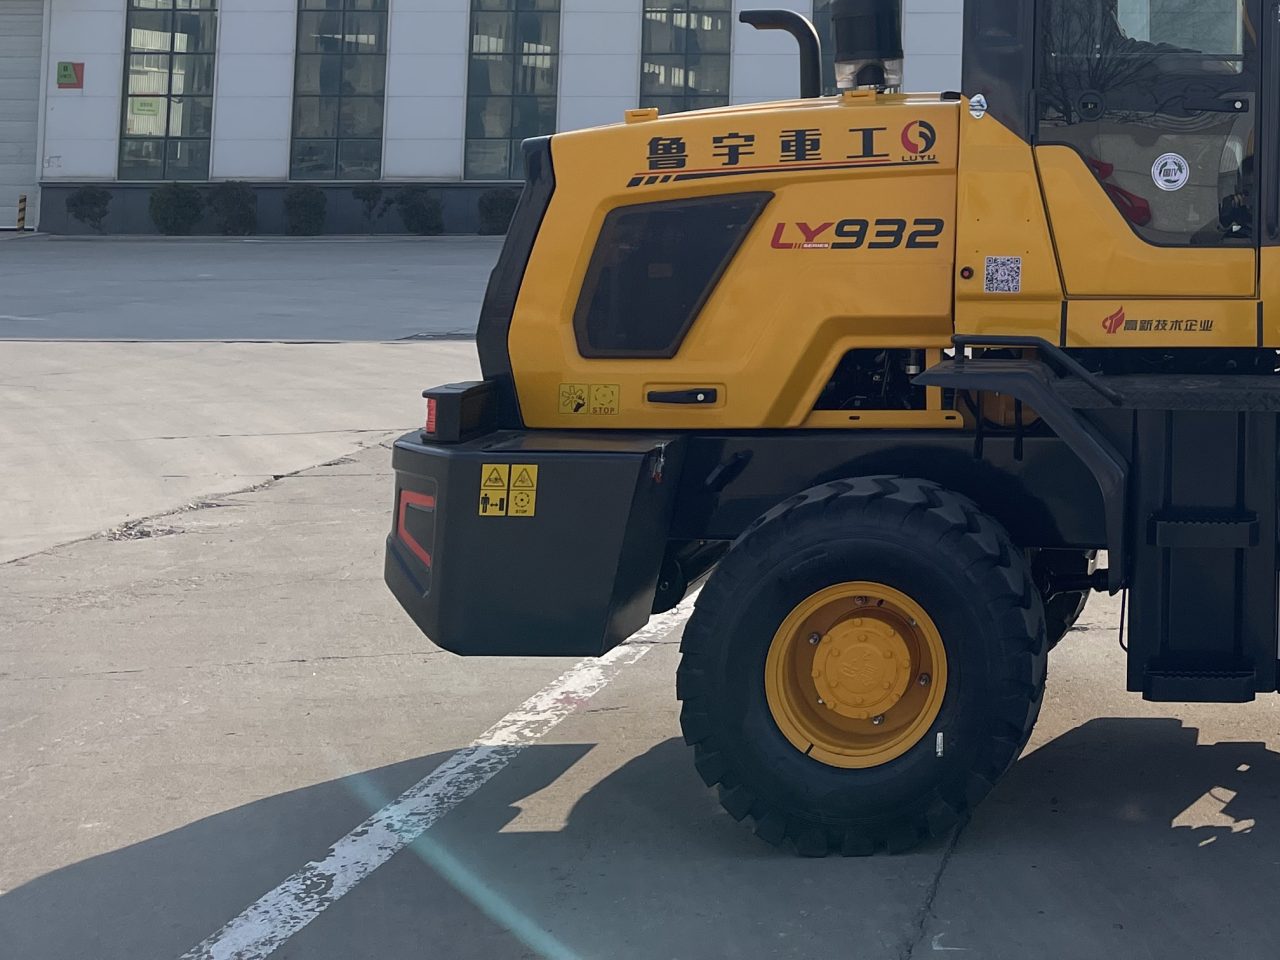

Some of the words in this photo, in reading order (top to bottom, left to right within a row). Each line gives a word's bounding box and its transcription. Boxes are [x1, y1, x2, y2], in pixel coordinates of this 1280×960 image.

[646, 127, 889, 169] 鲁宇重工
[771, 218, 945, 249] LY932
[1124, 319, 1214, 332] 高新技术企业
